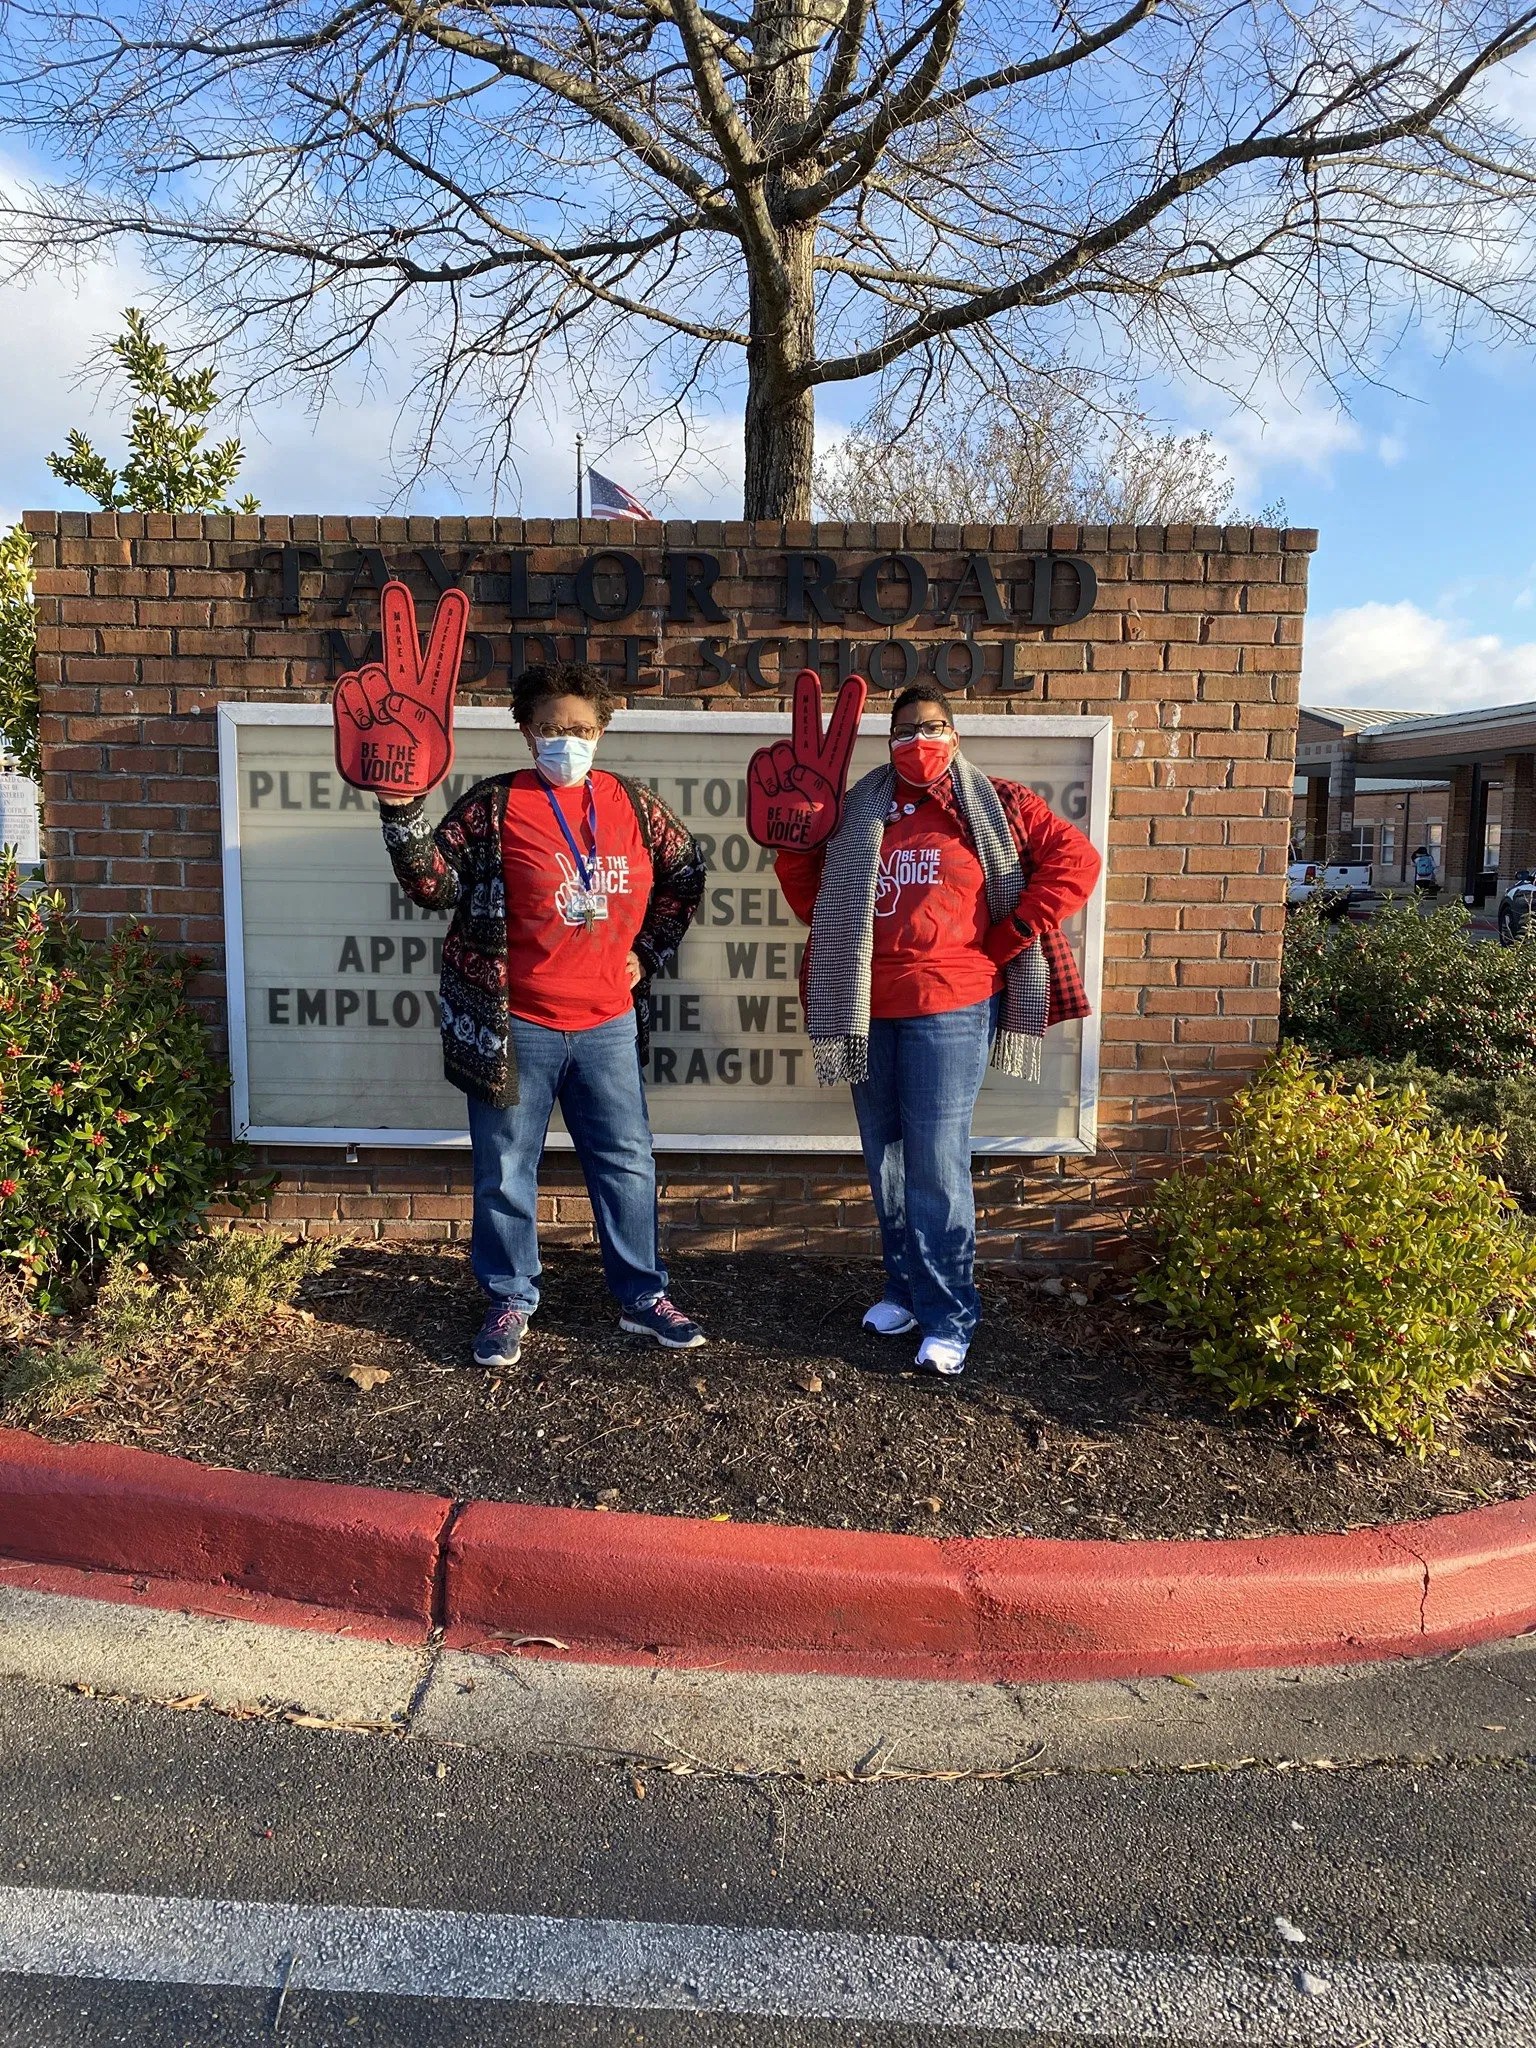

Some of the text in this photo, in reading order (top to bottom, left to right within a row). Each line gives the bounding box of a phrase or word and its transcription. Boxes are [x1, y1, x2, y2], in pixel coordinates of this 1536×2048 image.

[261, 548, 1098, 626] TAYLOR ROAD
[325, 631, 1035, 691] MDDE SCHOOL
[361, 742, 416, 762] BE THE
[250, 771, 381, 810] PLEA
[768, 807, 811, 824] BE THE
[606, 856, 629, 869] THE
[901, 849, 941, 862] BE THE
[643, 1047, 803, 1085] RAGUT
